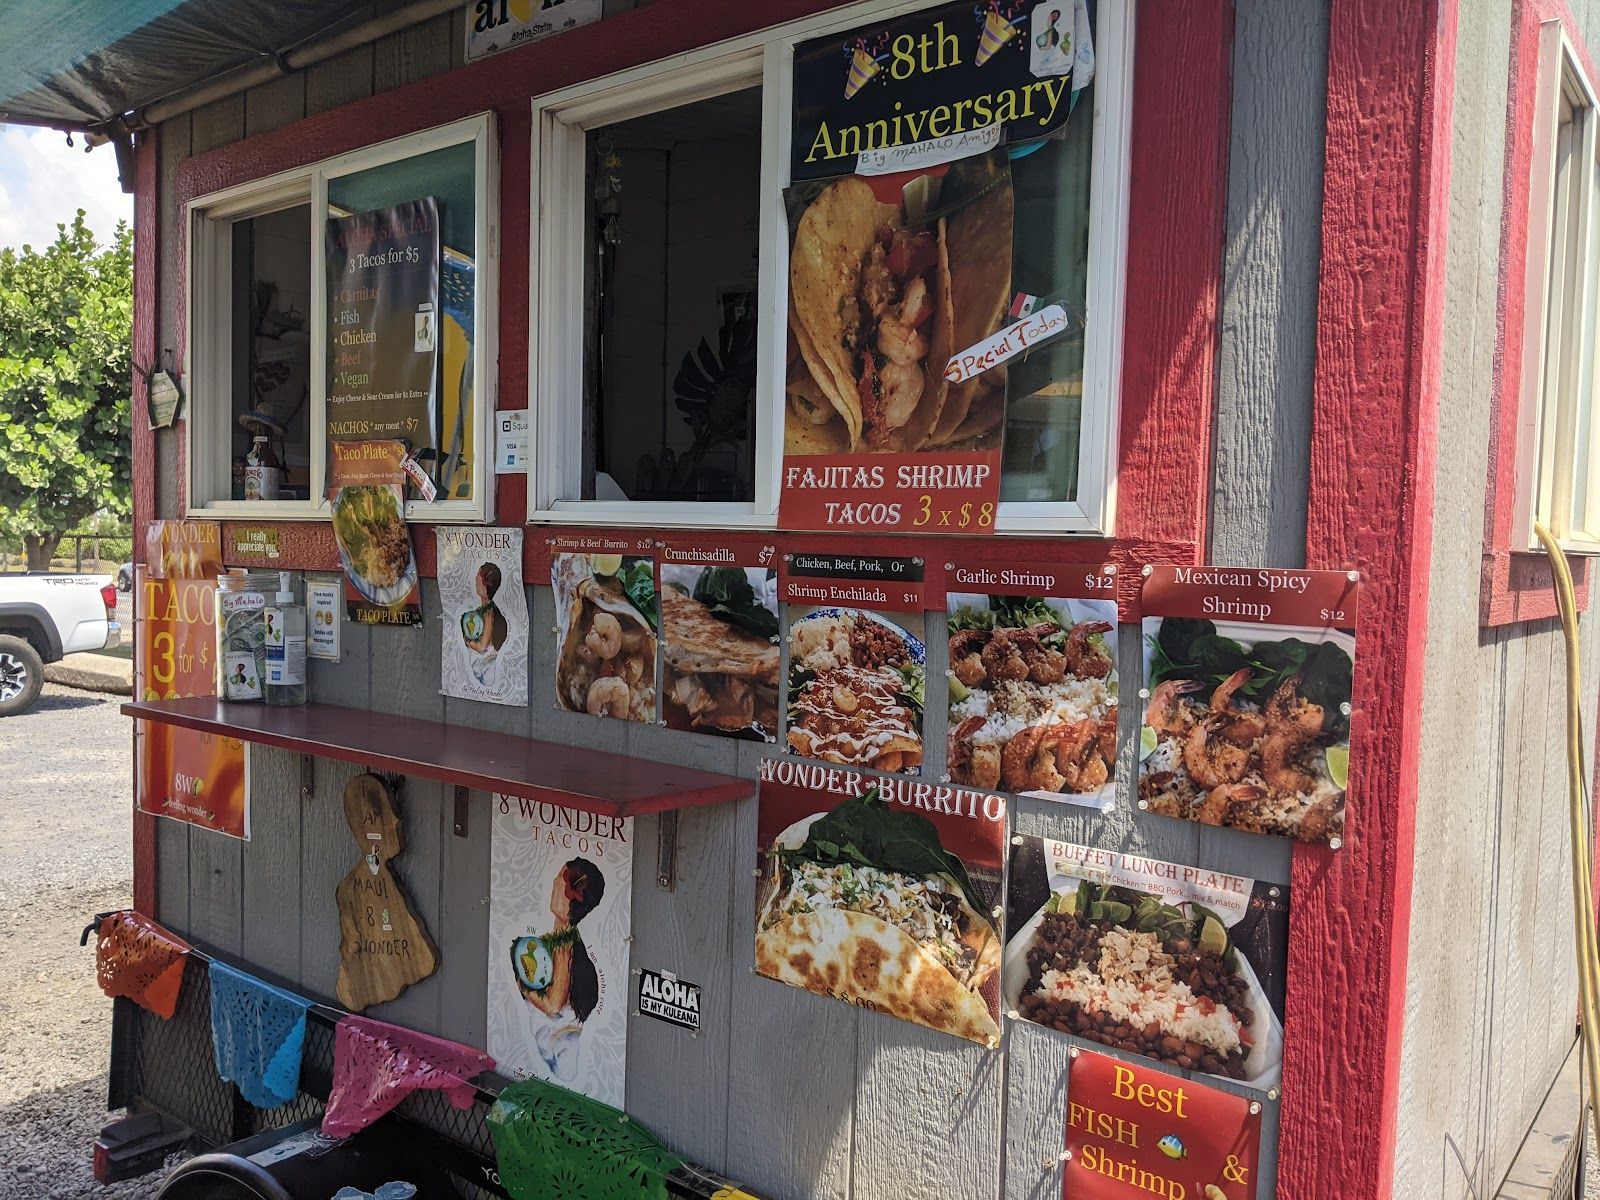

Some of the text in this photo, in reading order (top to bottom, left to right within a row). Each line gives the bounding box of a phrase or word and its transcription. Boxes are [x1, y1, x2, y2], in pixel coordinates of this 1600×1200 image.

[533, 22, 553, 36] State
[890, 21, 962, 80] 8th
[804, 75, 1070, 163] Anniversary
[860, 153, 885, 167] Big
[349, 245, 419, 273] 3 Tacos for $5
[341, 309, 360, 325] Fish
[341, 329, 377, 346] Chicken
[1008, 314, 1067, 346] Today
[341, 350, 361, 366] Beef
[341, 372, 369, 388] Vegan
[330, 416, 419, 435] NACHOS any meat $7
[336, 446, 361, 460] Taco
[362, 444, 388, 460] Plate
[786, 464, 991, 490] FAJITAS SHRIMP
[825, 502, 903, 525] TACOS
[913, 494, 932, 527] 3
[978, 502, 994, 527] 8
[151, 524, 216, 544] 8 WONDER
[246, 530, 268, 544] I really
[445, 531, 511, 549] 8 WONDER
[556, 537, 579, 550] Shrimp
[580, 538, 586, 548] &
[587, 538, 603, 549] Beef
[604, 539, 629, 550] Burrito
[236, 542, 265, 553] appreciate
[664, 546, 773, 566] Crunchisadilla $7
[796, 556, 905, 573] Chicken, Beef, Pork, Or
[42, 577, 74, 586] TRD
[956, 568, 1114, 591] Garlic Shrimp $12
[1174, 567, 1311, 594] Mexican Spicy
[143, 581, 215, 625] TACO
[223, 596, 264, 609] Big Mahalo
[788, 583, 919, 604] Shrimp Enchilada $11
[356, 608, 380, 622] TACO
[381, 610, 412, 624] PLATE
[1202, 596, 1346, 621] Shrimp $12
[153, 631, 176, 684] 3
[178, 643, 195, 674] for
[175, 772, 193, 795] 8W
[760, 757, 1008, 823] WONDER BURRITO
[187, 805, 208, 819] wonder
[361, 810, 386, 826] AM
[499, 794, 628, 844] 8 WONDER
[532, 825, 605, 858] TACOS
[1052, 842, 1119, 866] BUFFET
[1121, 857, 1179, 881] LUNCH
[1183, 868, 1246, 895] PLATE
[352, 877, 389, 899] MAUI
[1112, 875, 1140, 889] Chicken
[1148, 882, 1165, 895] BBQ
[1191, 892, 1206, 902] mix
[1207, 894, 1215, 905] &
[1215, 898, 1242, 911] match
[366, 906, 376, 928] 8
[641, 973, 699, 1012] ALOHA
[642, 998, 698, 1026] IS MY KULEANA
[1112, 1064, 1189, 1119] Best
[1067, 1101, 1249, 1186] FISH &
[1080, 1144, 1187, 1200] Shrimp
